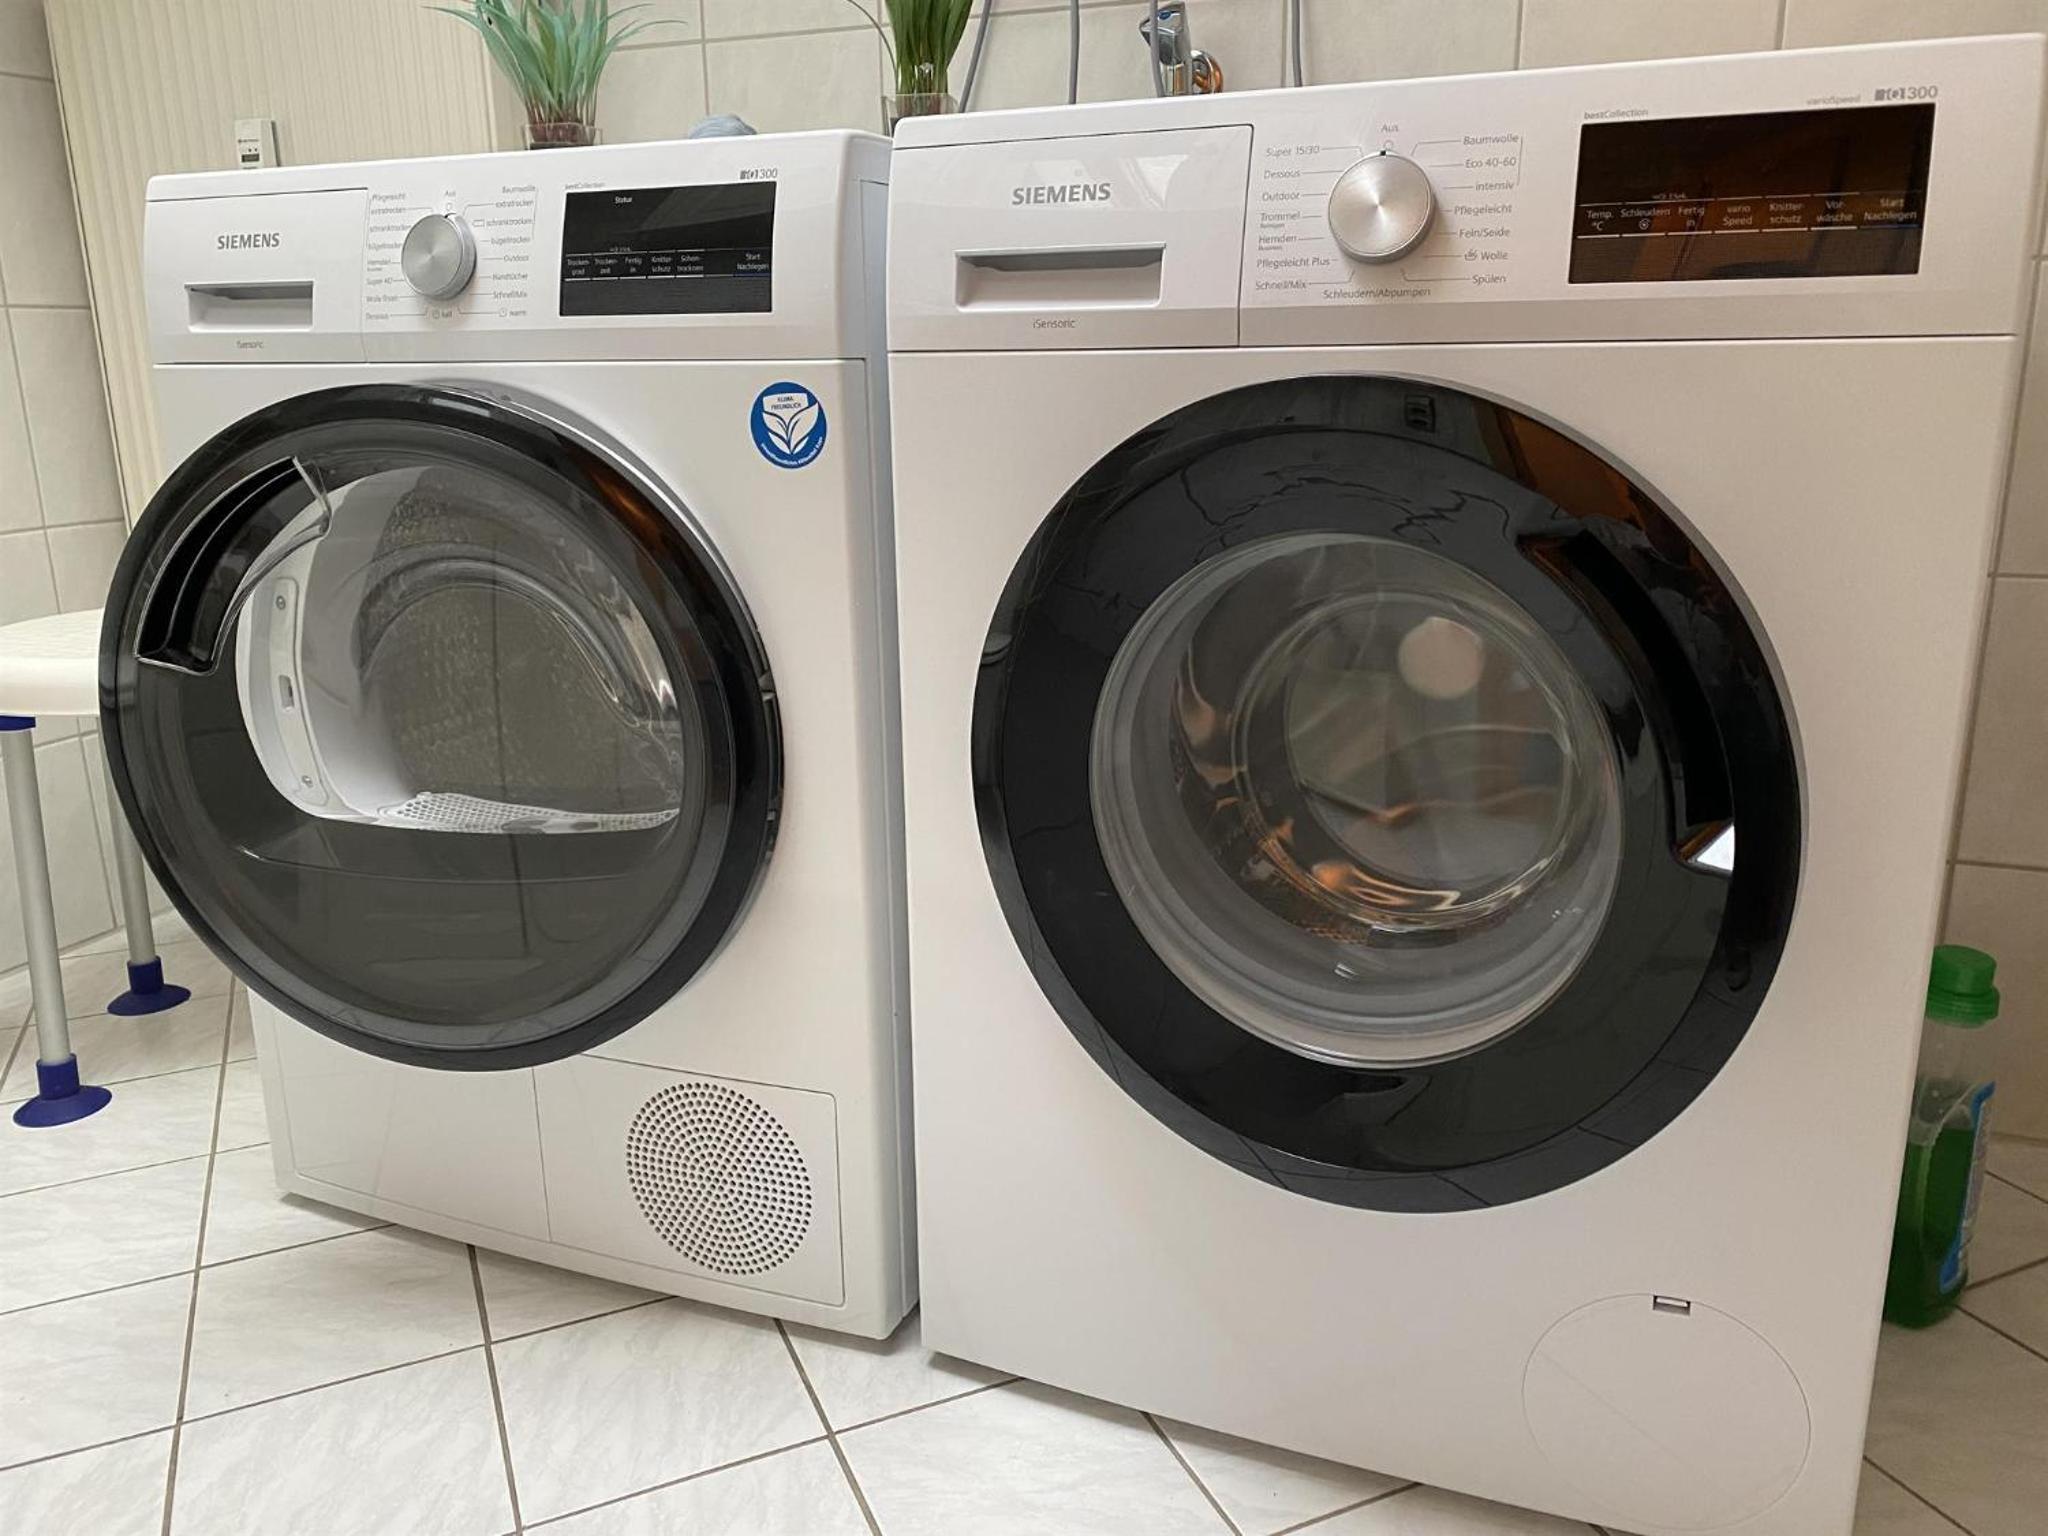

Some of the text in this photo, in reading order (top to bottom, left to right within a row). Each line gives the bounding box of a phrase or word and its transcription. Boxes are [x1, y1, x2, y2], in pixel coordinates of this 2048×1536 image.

[1381, 123, 1399, 132] Aus
[1463, 134, 1519, 145] Baumwolle
[1266, 147, 1292, 157] Super
[1465, 156, 1517, 169] Eco 40-60
[1264, 169, 1301, 179] Dessous
[1475, 181, 1514, 191] intensiv
[1012, 182, 1111, 206] SIEMENS
[1262, 191, 1300, 201] Outdoor
[1260, 212, 1300, 221] Trommel
[1454, 206, 1512, 217] Pflegeleicht
[1620, 207, 1671, 218] Schleudern
[1459, 227, 1511, 238] Fein/Seide
[217, 232, 280, 250] SIEMENS
[1258, 235, 1297, 244] Hemden
[1481, 250, 1509, 261] Wolle
[1256, 256, 1330, 269] Pflegeleicht Plus
[1256, 279, 1307, 291] Schnell/Mix
[1472, 273, 1507, 286] Spülen
[1323, 288, 1431, 301] Schleudern/Abpumpen
[1033, 319, 1076, 329] iSensoric
